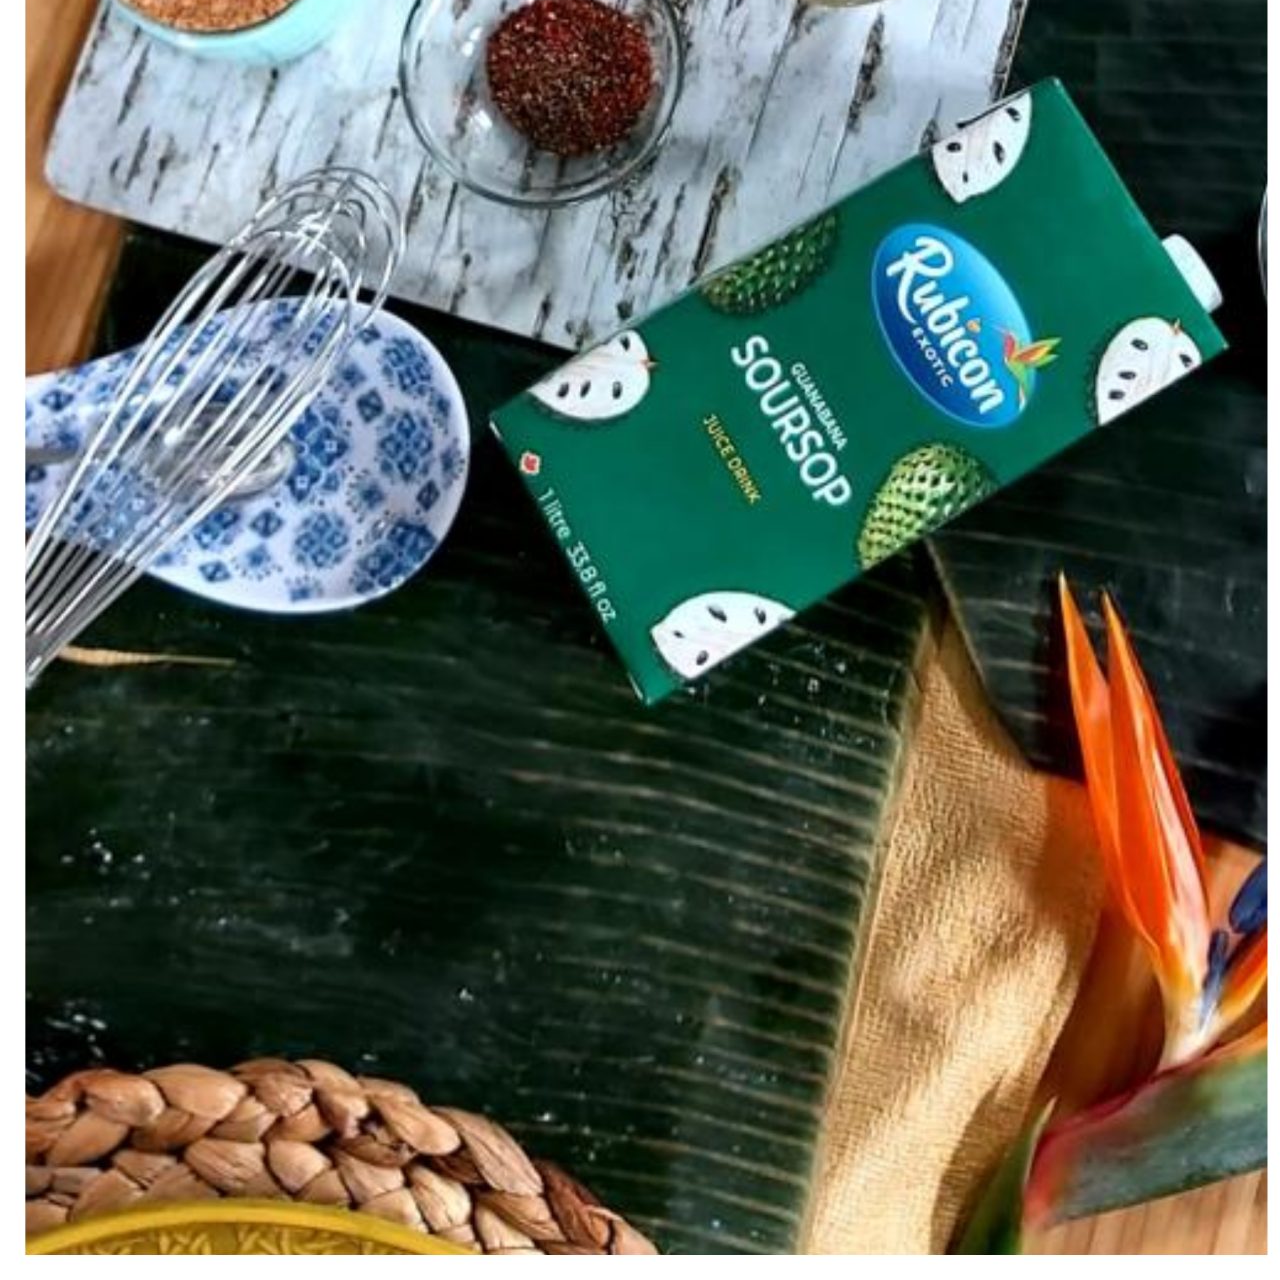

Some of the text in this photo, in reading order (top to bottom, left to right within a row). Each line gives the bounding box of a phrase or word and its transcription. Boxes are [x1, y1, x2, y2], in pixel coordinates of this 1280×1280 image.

[886, 236, 1005, 415] Rubicon
[912, 326, 954, 388] EXOTIC
[730, 335, 853, 506] SOURSOP
[790, 362, 848, 451] GUANABANA
[703, 413, 762, 504] JUICE DRINK
[538, 487, 554, 501] 1
[543, 499, 571, 540] litre
[566, 541, 598, 583] 33.8
[597, 598, 617, 624] oz
